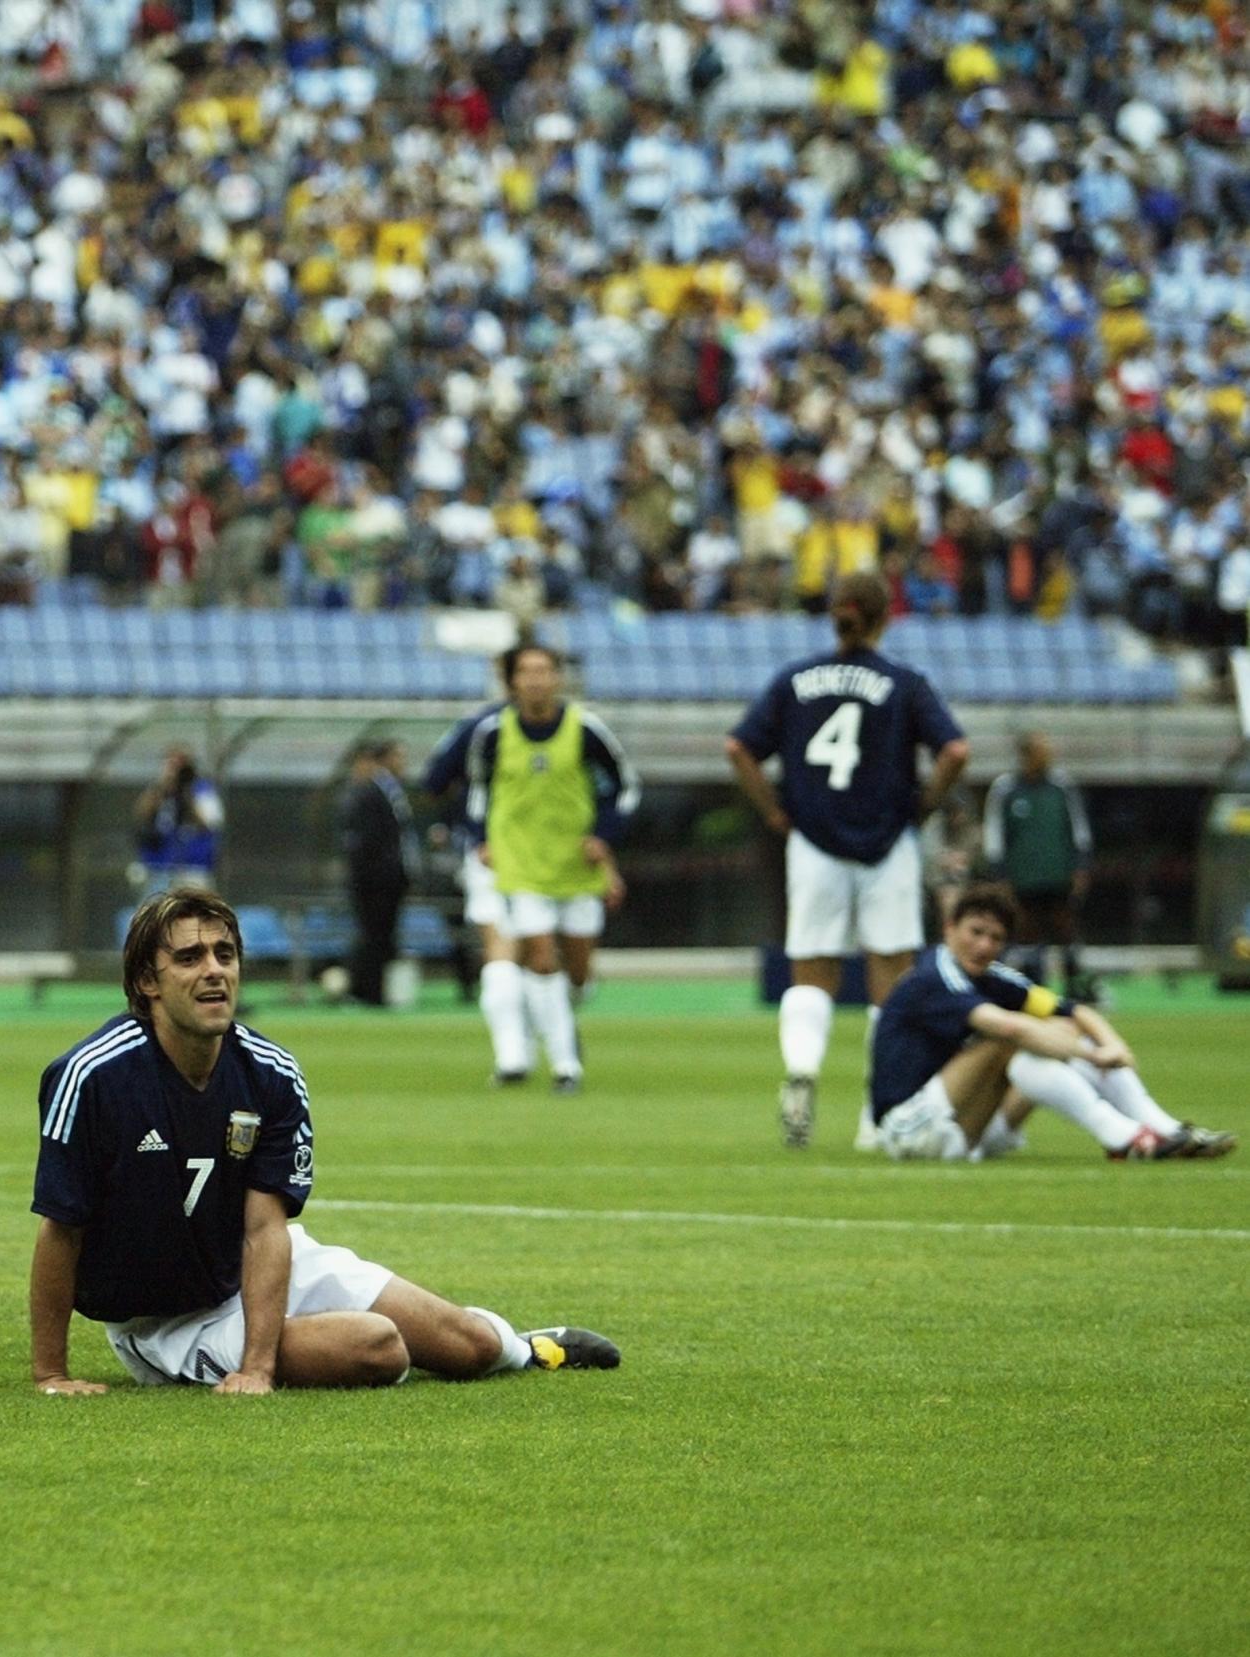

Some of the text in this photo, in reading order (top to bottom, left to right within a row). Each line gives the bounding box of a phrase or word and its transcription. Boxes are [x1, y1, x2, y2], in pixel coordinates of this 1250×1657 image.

[805, 701, 863, 792] 4
[137, 1143, 169, 1152] adidas
[183, 1158, 215, 1217] 7
